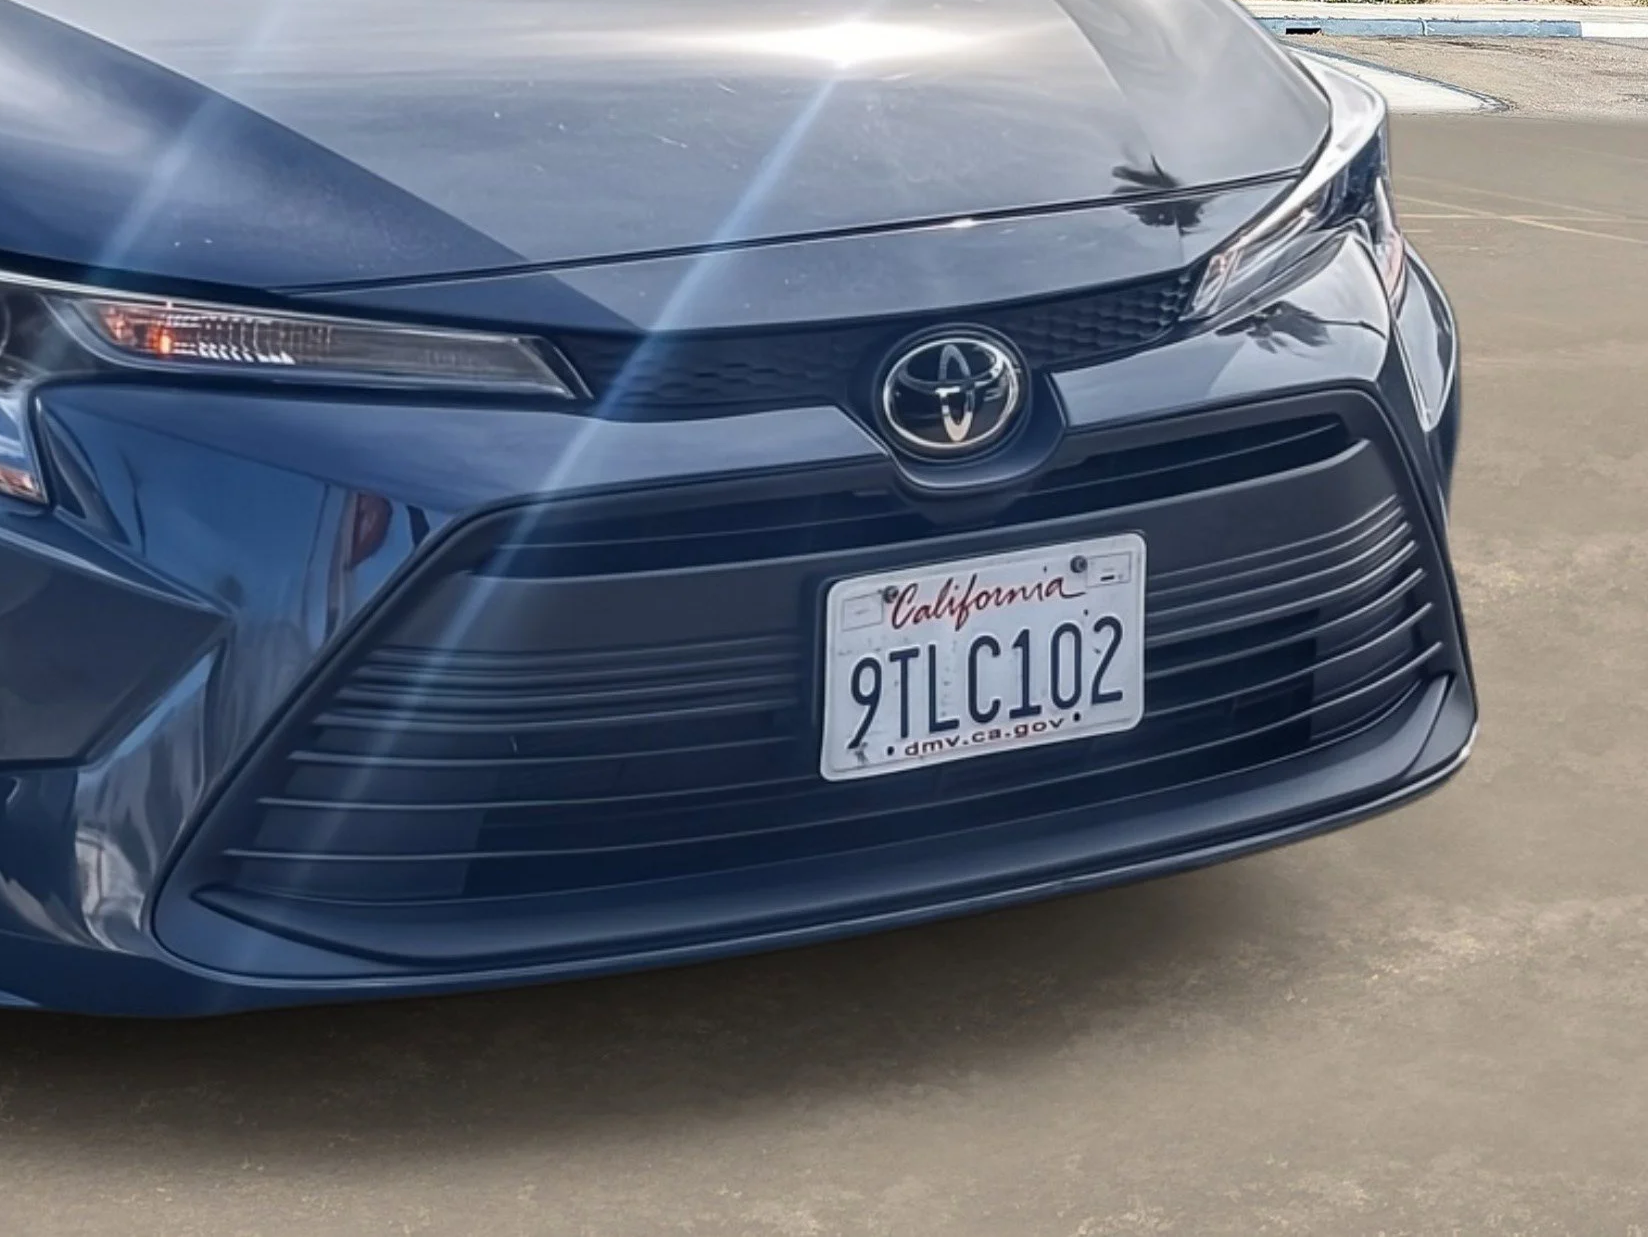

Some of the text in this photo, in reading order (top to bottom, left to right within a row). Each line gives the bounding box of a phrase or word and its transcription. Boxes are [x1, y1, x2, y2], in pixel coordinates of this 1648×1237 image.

[890, 572, 1087, 632] California
[846, 615, 1124, 750] 9TLC102
[904, 715, 1065, 757] dmv.ca.gov
